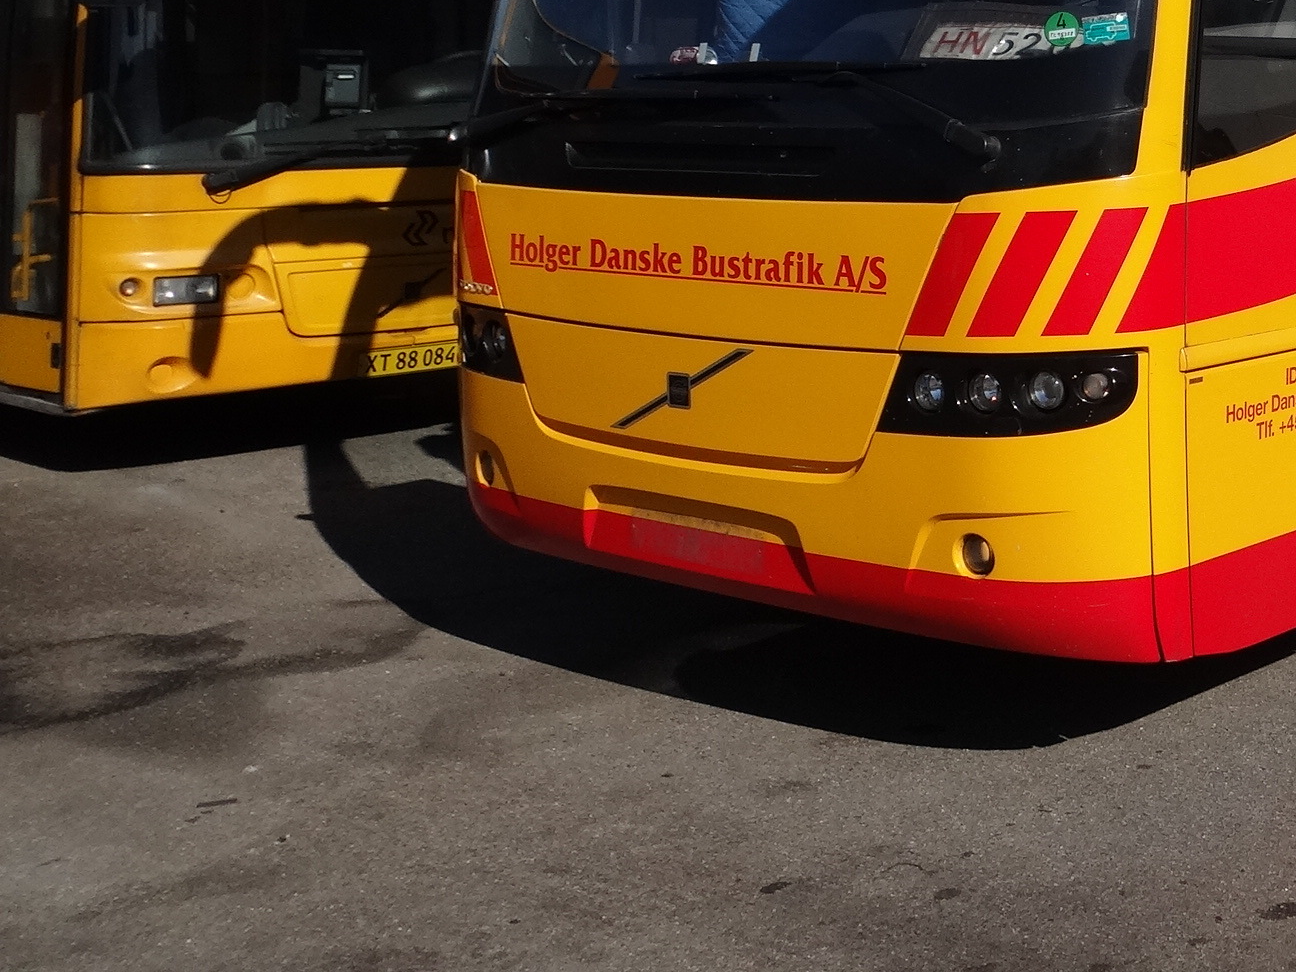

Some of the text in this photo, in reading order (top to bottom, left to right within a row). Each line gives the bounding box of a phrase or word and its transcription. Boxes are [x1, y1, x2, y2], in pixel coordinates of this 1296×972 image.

[1056, 13, 1067, 28] 4
[932, 30, 992, 56] HN
[510, 233, 888, 293] Holger Danske Bustrafik A/S
[367, 346, 455, 373] XT 88 084
[1226, 399, 1268, 423] Holger
[1256, 419, 1275, 440] Tlf.
